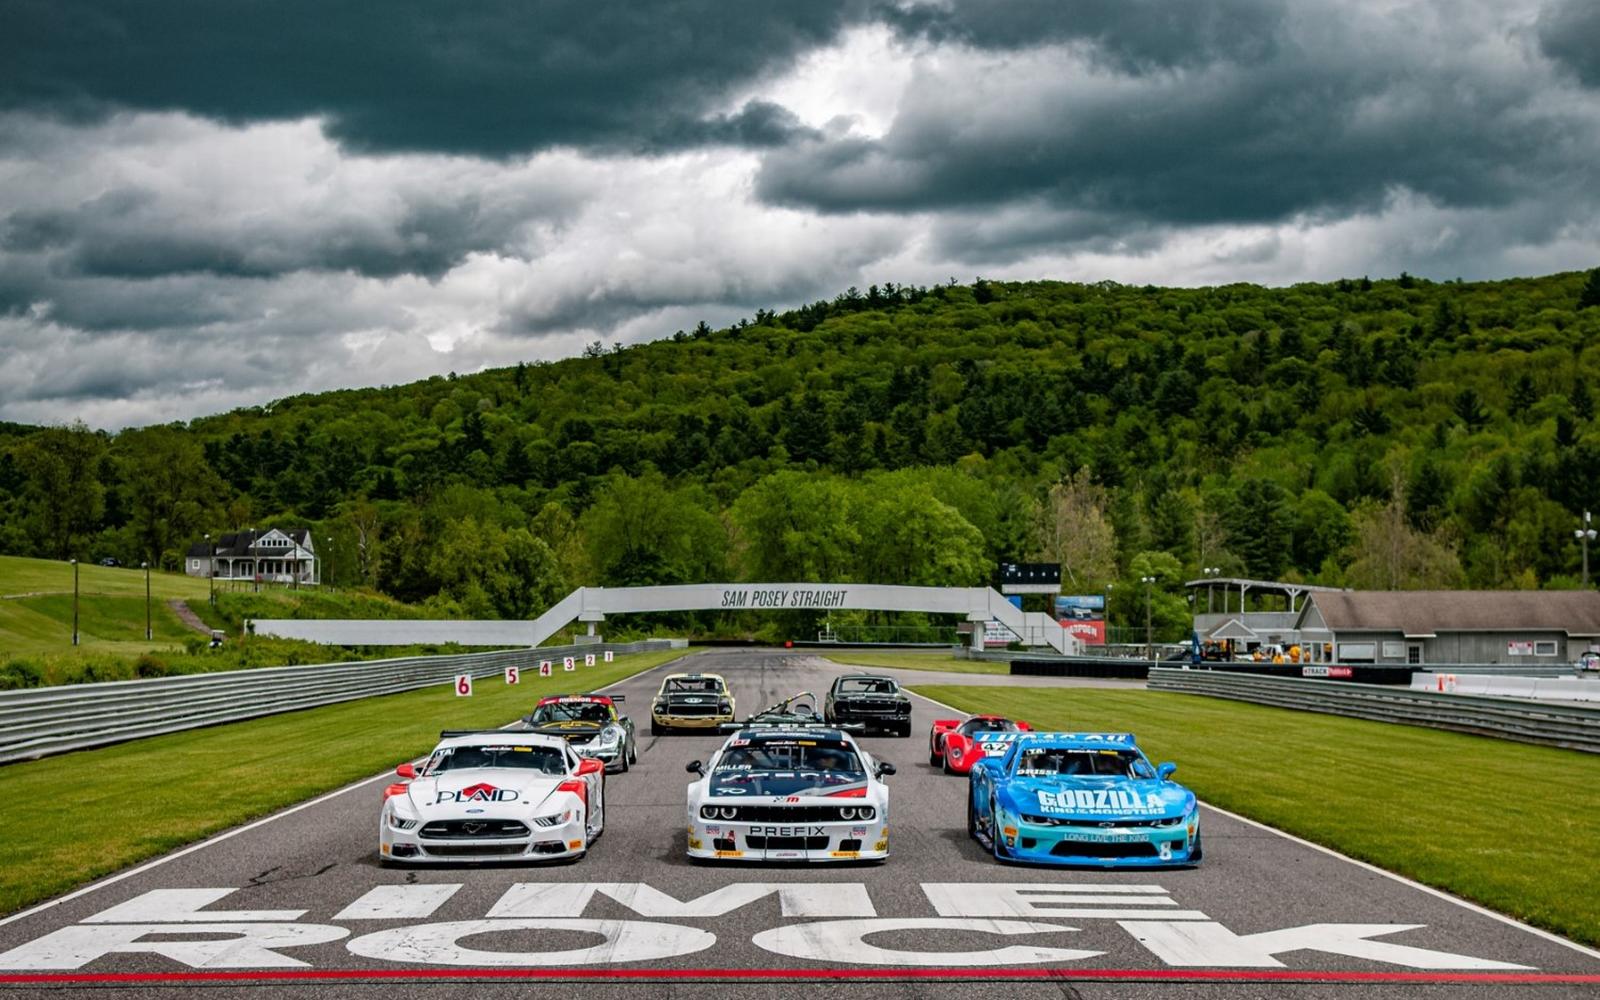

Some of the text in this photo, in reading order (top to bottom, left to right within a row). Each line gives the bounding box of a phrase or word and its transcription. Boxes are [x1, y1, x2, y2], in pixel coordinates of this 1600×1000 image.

[721, 591, 847, 607] SAM POSEY STRAIGHT
[566, 659, 573, 670] 3
[587, 656, 594, 665] 2
[508, 668, 517, 684] 5
[541, 663, 550, 676] 4
[458, 677, 470, 695] 6
[436, 789, 519, 804] PLAID
[1037, 790, 1165, 808] GODZILLA
[1040, 806, 1075, 814] KING
[749, 826, 825, 836] PREFIX
[1064, 833, 1149, 842] LONG LIVE THE KING
[1159, 843, 1172, 860] 8
[79, 883, 1211, 923] LIME
[0, 917, 1540, 970] ROCK
